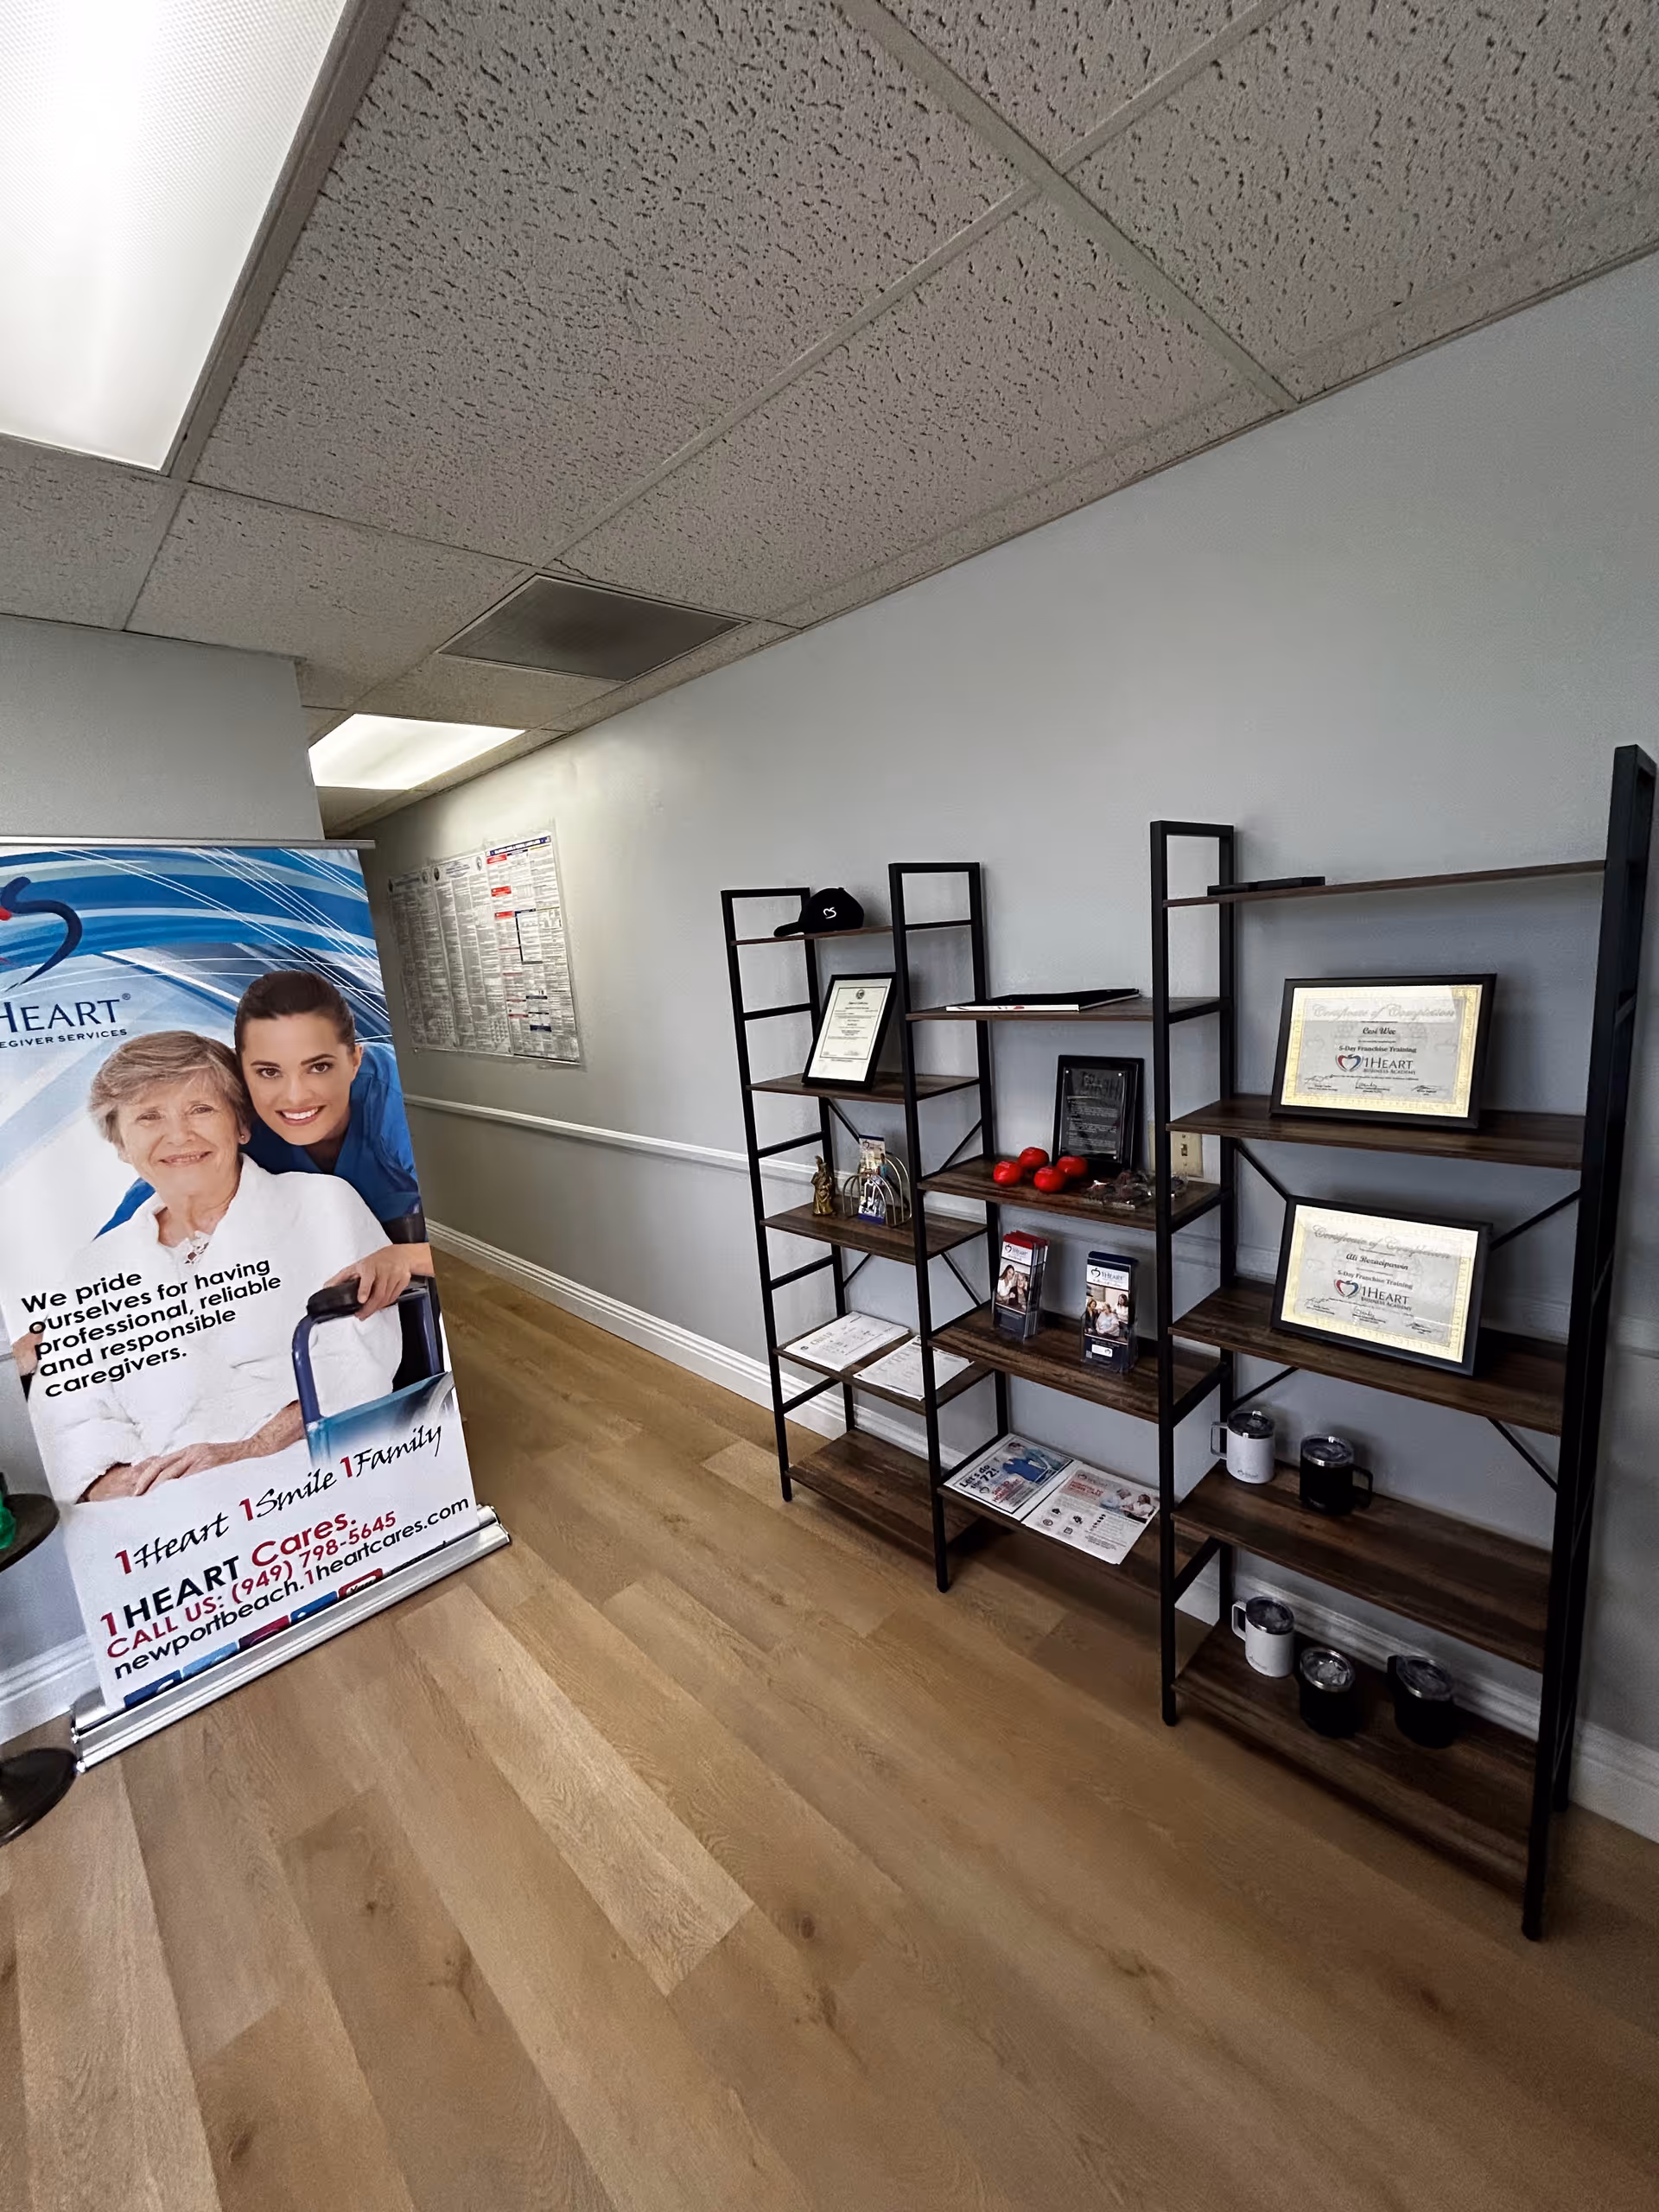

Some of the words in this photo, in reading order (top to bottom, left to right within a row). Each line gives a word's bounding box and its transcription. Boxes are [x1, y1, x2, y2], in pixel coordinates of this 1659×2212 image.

[58, 1029, 127, 1042] SERVICES
[21, 1293, 67, 1313] We
[76, 1272, 142, 1304] pride
[29, 1292, 152, 1335] ourselves
[157, 1281, 188, 1300] for
[194, 1260, 270, 1290] having
[1386, 1279, 1414, 1290] Training
[35, 1300, 194, 1361] professional,
[200, 1274, 282, 1309] reliable
[40, 1349, 93, 1376] and
[101, 1309, 237, 1359] responsible
[45, 1345, 188, 1397] caregivers.
[980, 1465, 990, 1474] do
[980, 1468, 1000, 1483] 72!
[115, 1512, 229, 1575] 1Heart
[251, 1510, 356, 1570] Cares.
[106, 1617, 179, 1658] CALL
[184, 1592, 225, 1622] US:
[232, 1560, 294, 1605] (949)
[298, 1510, 397, 1572] 798-5645
[113, 1496, 470, 1680] newportbeach.1heartcares.com
